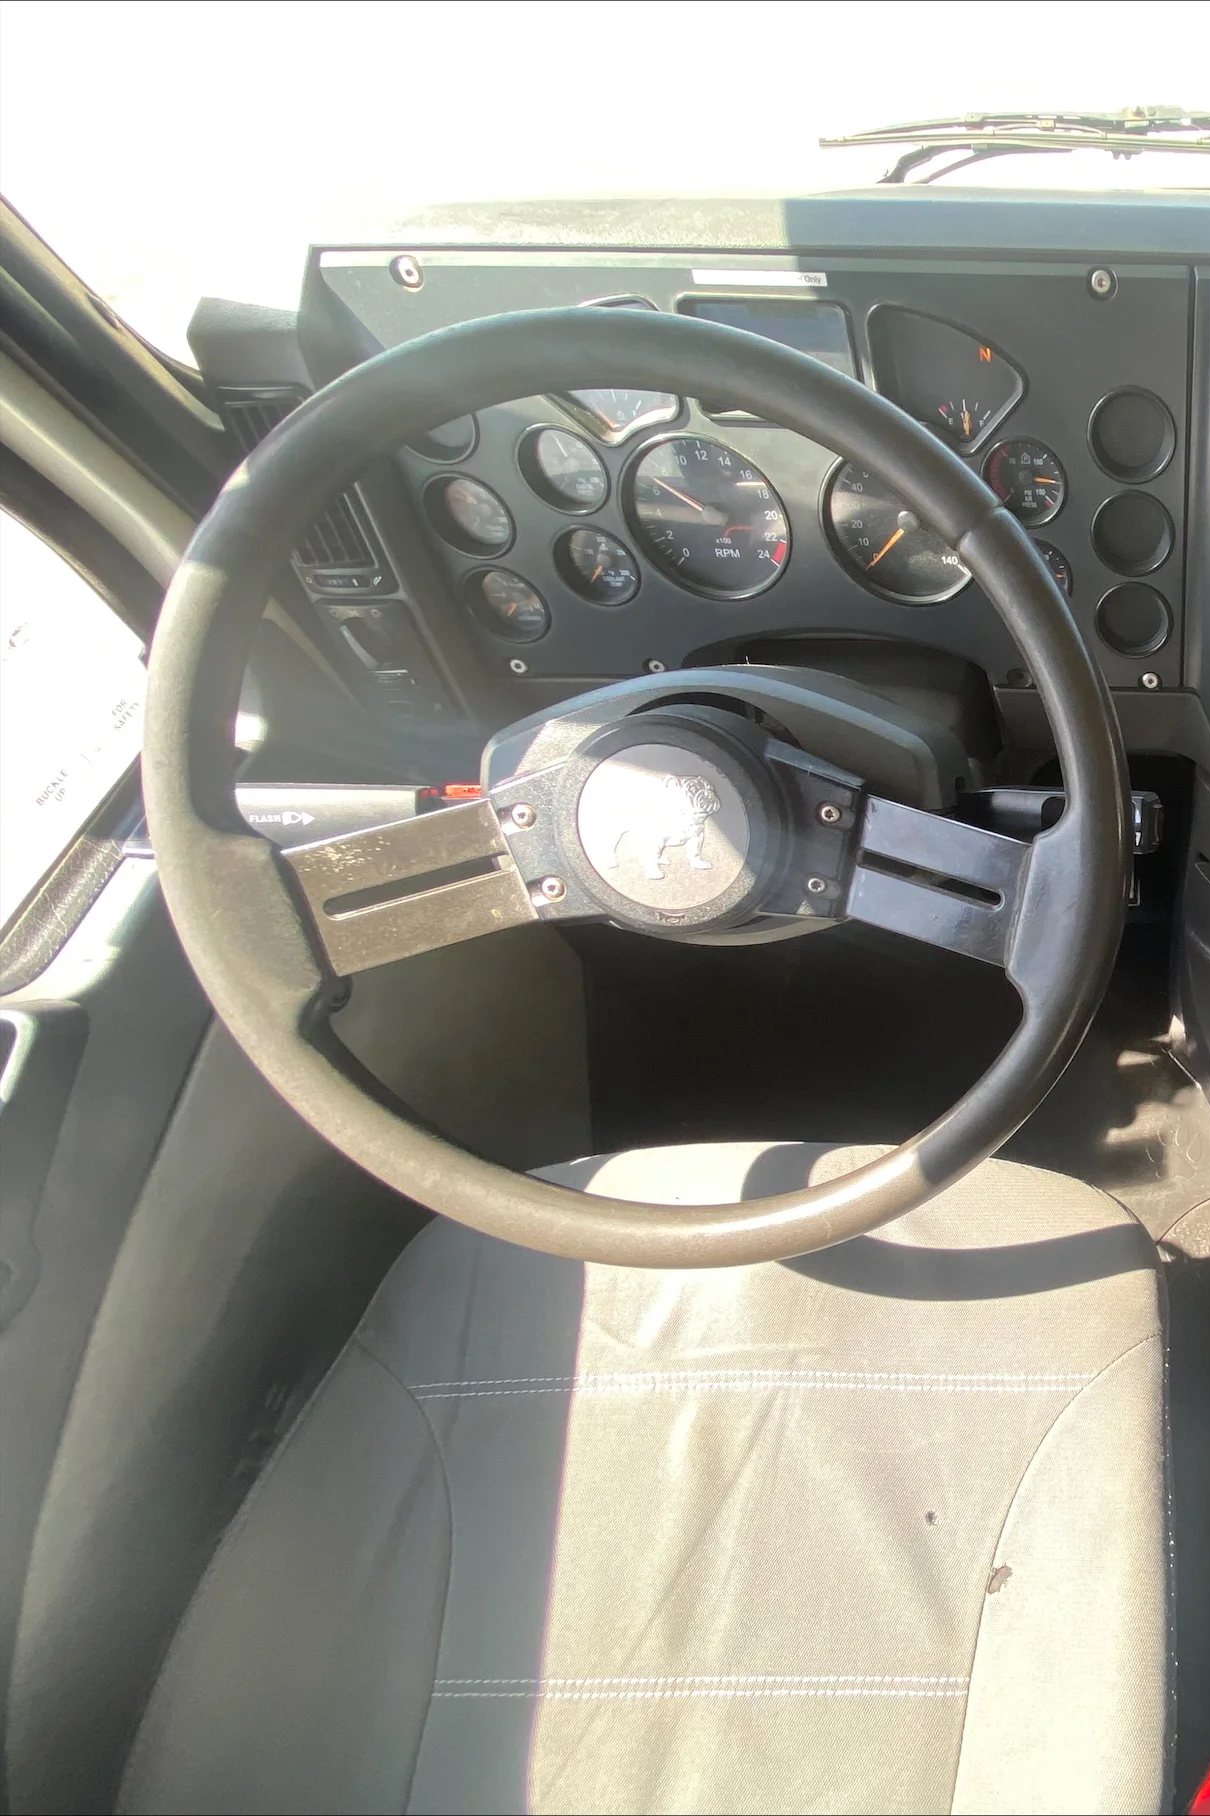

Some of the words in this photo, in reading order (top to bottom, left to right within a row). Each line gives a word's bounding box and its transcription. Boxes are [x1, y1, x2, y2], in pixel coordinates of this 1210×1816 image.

[804, 275, 821, 285] Only
[979, 347, 992, 362] N
[676, 455, 687, 466] 10
[695, 450, 708, 461] 12
[718, 456, 732, 467] 14
[739, 470, 753, 480] 16
[652, 487, 660, 496] 6
[851, 483, 863, 492] 40
[757, 489, 769, 499] 18
[765, 510, 778, 520] 20
[852, 520, 863, 528] 20
[666, 530, 674, 540] 2
[765, 532, 777, 542] 22
[858, 538, 869, 546] 10
[682, 548, 690, 558] 0
[715, 549, 740, 559] RPM
[757, 549, 770, 559] 24
[941, 556, 958, 565] 140
[111, 699, 128, 717] FOR
[36, 769, 68, 806] BUCKLE
[54, 788, 66, 802] UP
